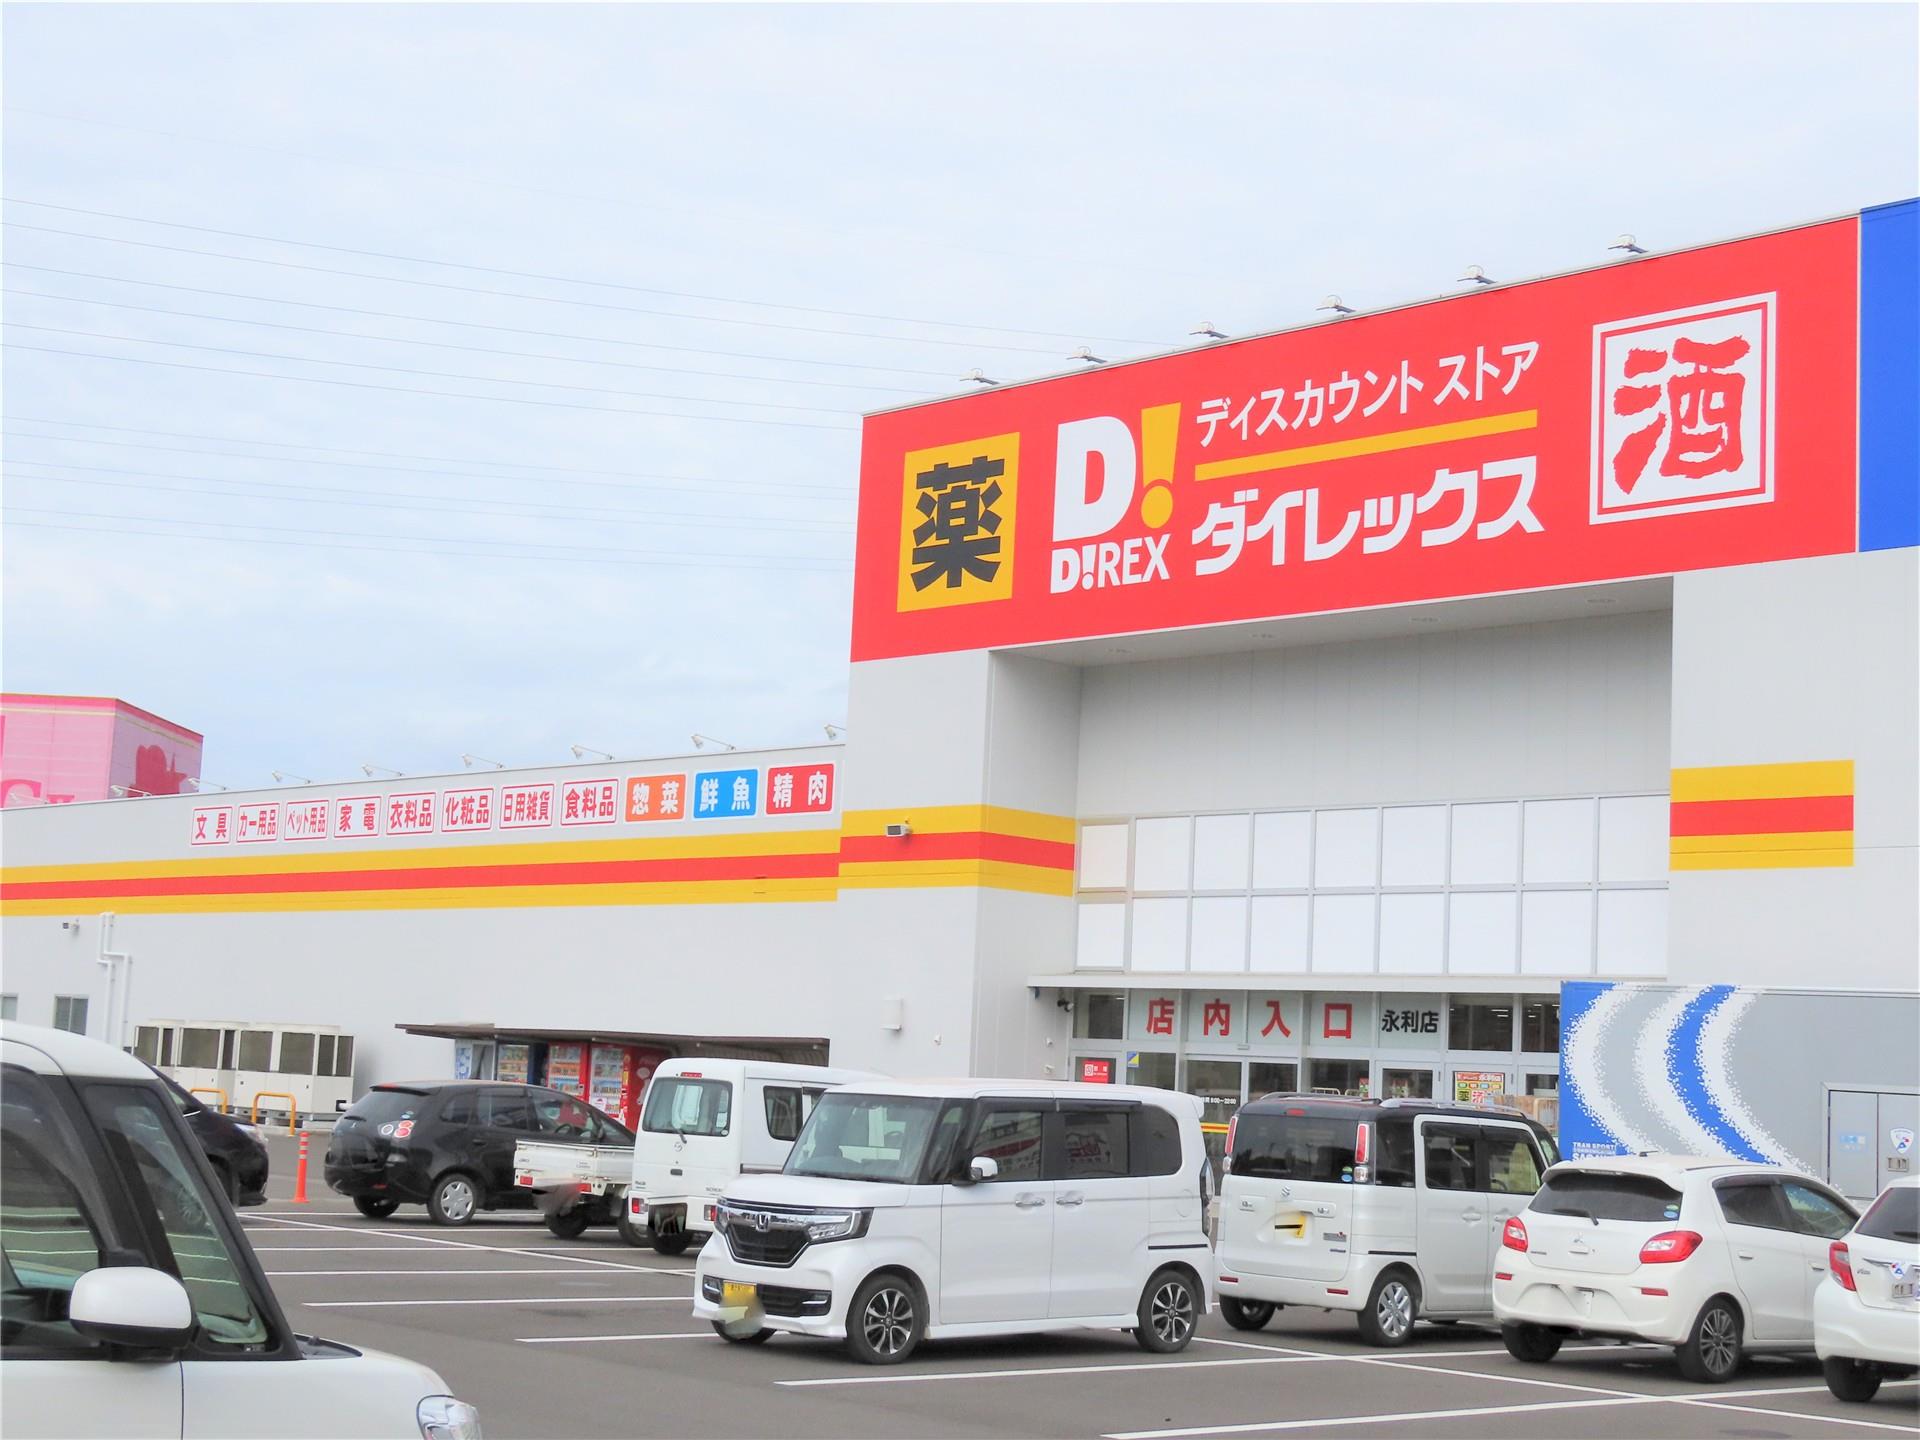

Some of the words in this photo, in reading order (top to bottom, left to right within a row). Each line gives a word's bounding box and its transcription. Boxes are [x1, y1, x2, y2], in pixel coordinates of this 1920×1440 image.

[1194, 357, 1426, 449] ディスカウント
[1432, 341, 1541, 406] ストア
[1614, 336, 1748, 496] 酒
[911, 456, 1005, 591] 薬
[1190, 454, 1546, 577] ダイレックス
[1050, 532, 1172, 594] D!REX
[564, 786, 614, 819] 食料品
[631, 781, 680, 815] 惣菜
[699, 776, 751, 812] 鮮魚
[773, 771, 828, 809] 精肉
[239, 809, 276, 837] カー用品
[287, 805, 326, 836] ペット用品
[339, 802, 376, 831] 家電
[390, 799, 432, 829] 衣料品
[445, 795, 490, 825] 化粧品
[504, 792, 551, 823] 日用雑貨
[195, 814, 228, 840] 文具
[1146, 997, 1353, 1040] 店内入口
[1381, 1009, 1440, 1034] 永利店
